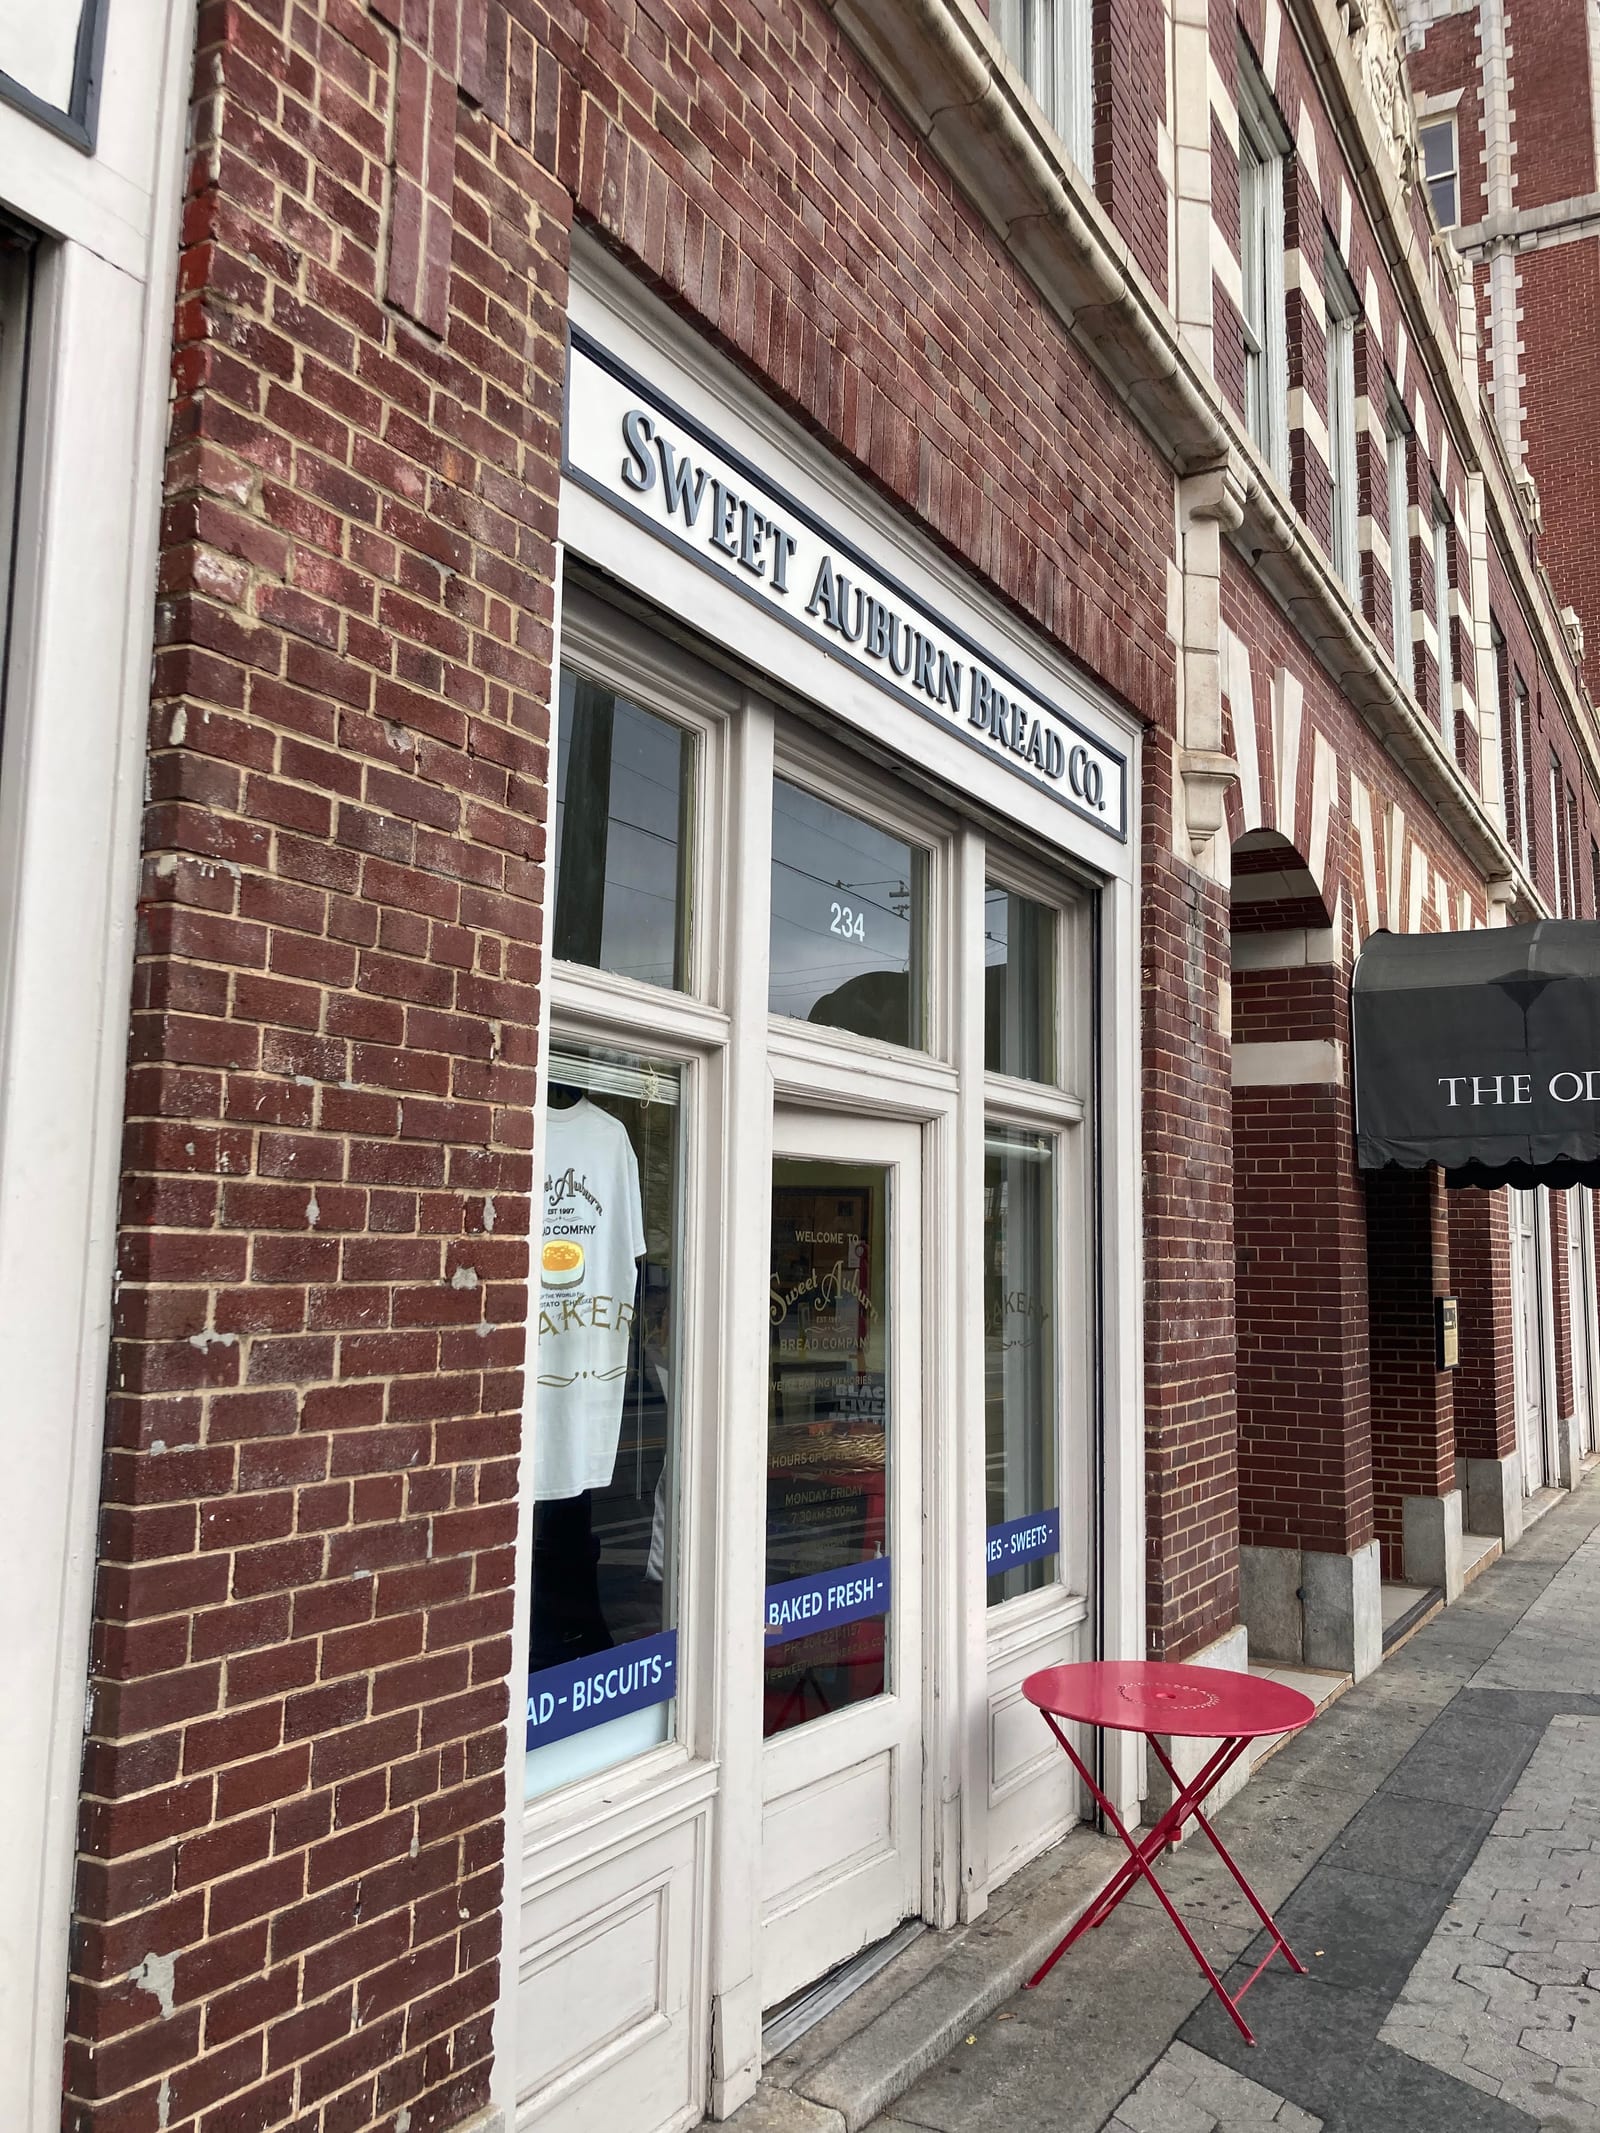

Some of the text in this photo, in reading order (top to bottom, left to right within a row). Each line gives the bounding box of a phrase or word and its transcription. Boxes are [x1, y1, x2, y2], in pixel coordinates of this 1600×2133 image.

[621, 409, 797, 593] SWEET
[805, 555, 965, 712] AUBURN
[968, 665, 1064, 779] BREAD
[830, 902, 865, 942] 234
[1438, 1074, 1533, 1107] THE
[549, 1168, 603, 1217] Auburn
[795, 1230, 859, 1245] WELCOME TO
[770, 1260, 879, 1326] Sweet Auburn
[780, 1338, 819, 1351] BREAD
[771, 1452, 810, 1469] HOURS
[1011, 1524, 1047, 1554] SWEETS
[769, 1591, 822, 1626] BAKED
[828, 1577, 874, 1612] FRESH
[572, 1654, 662, 1712] BISCUITS
